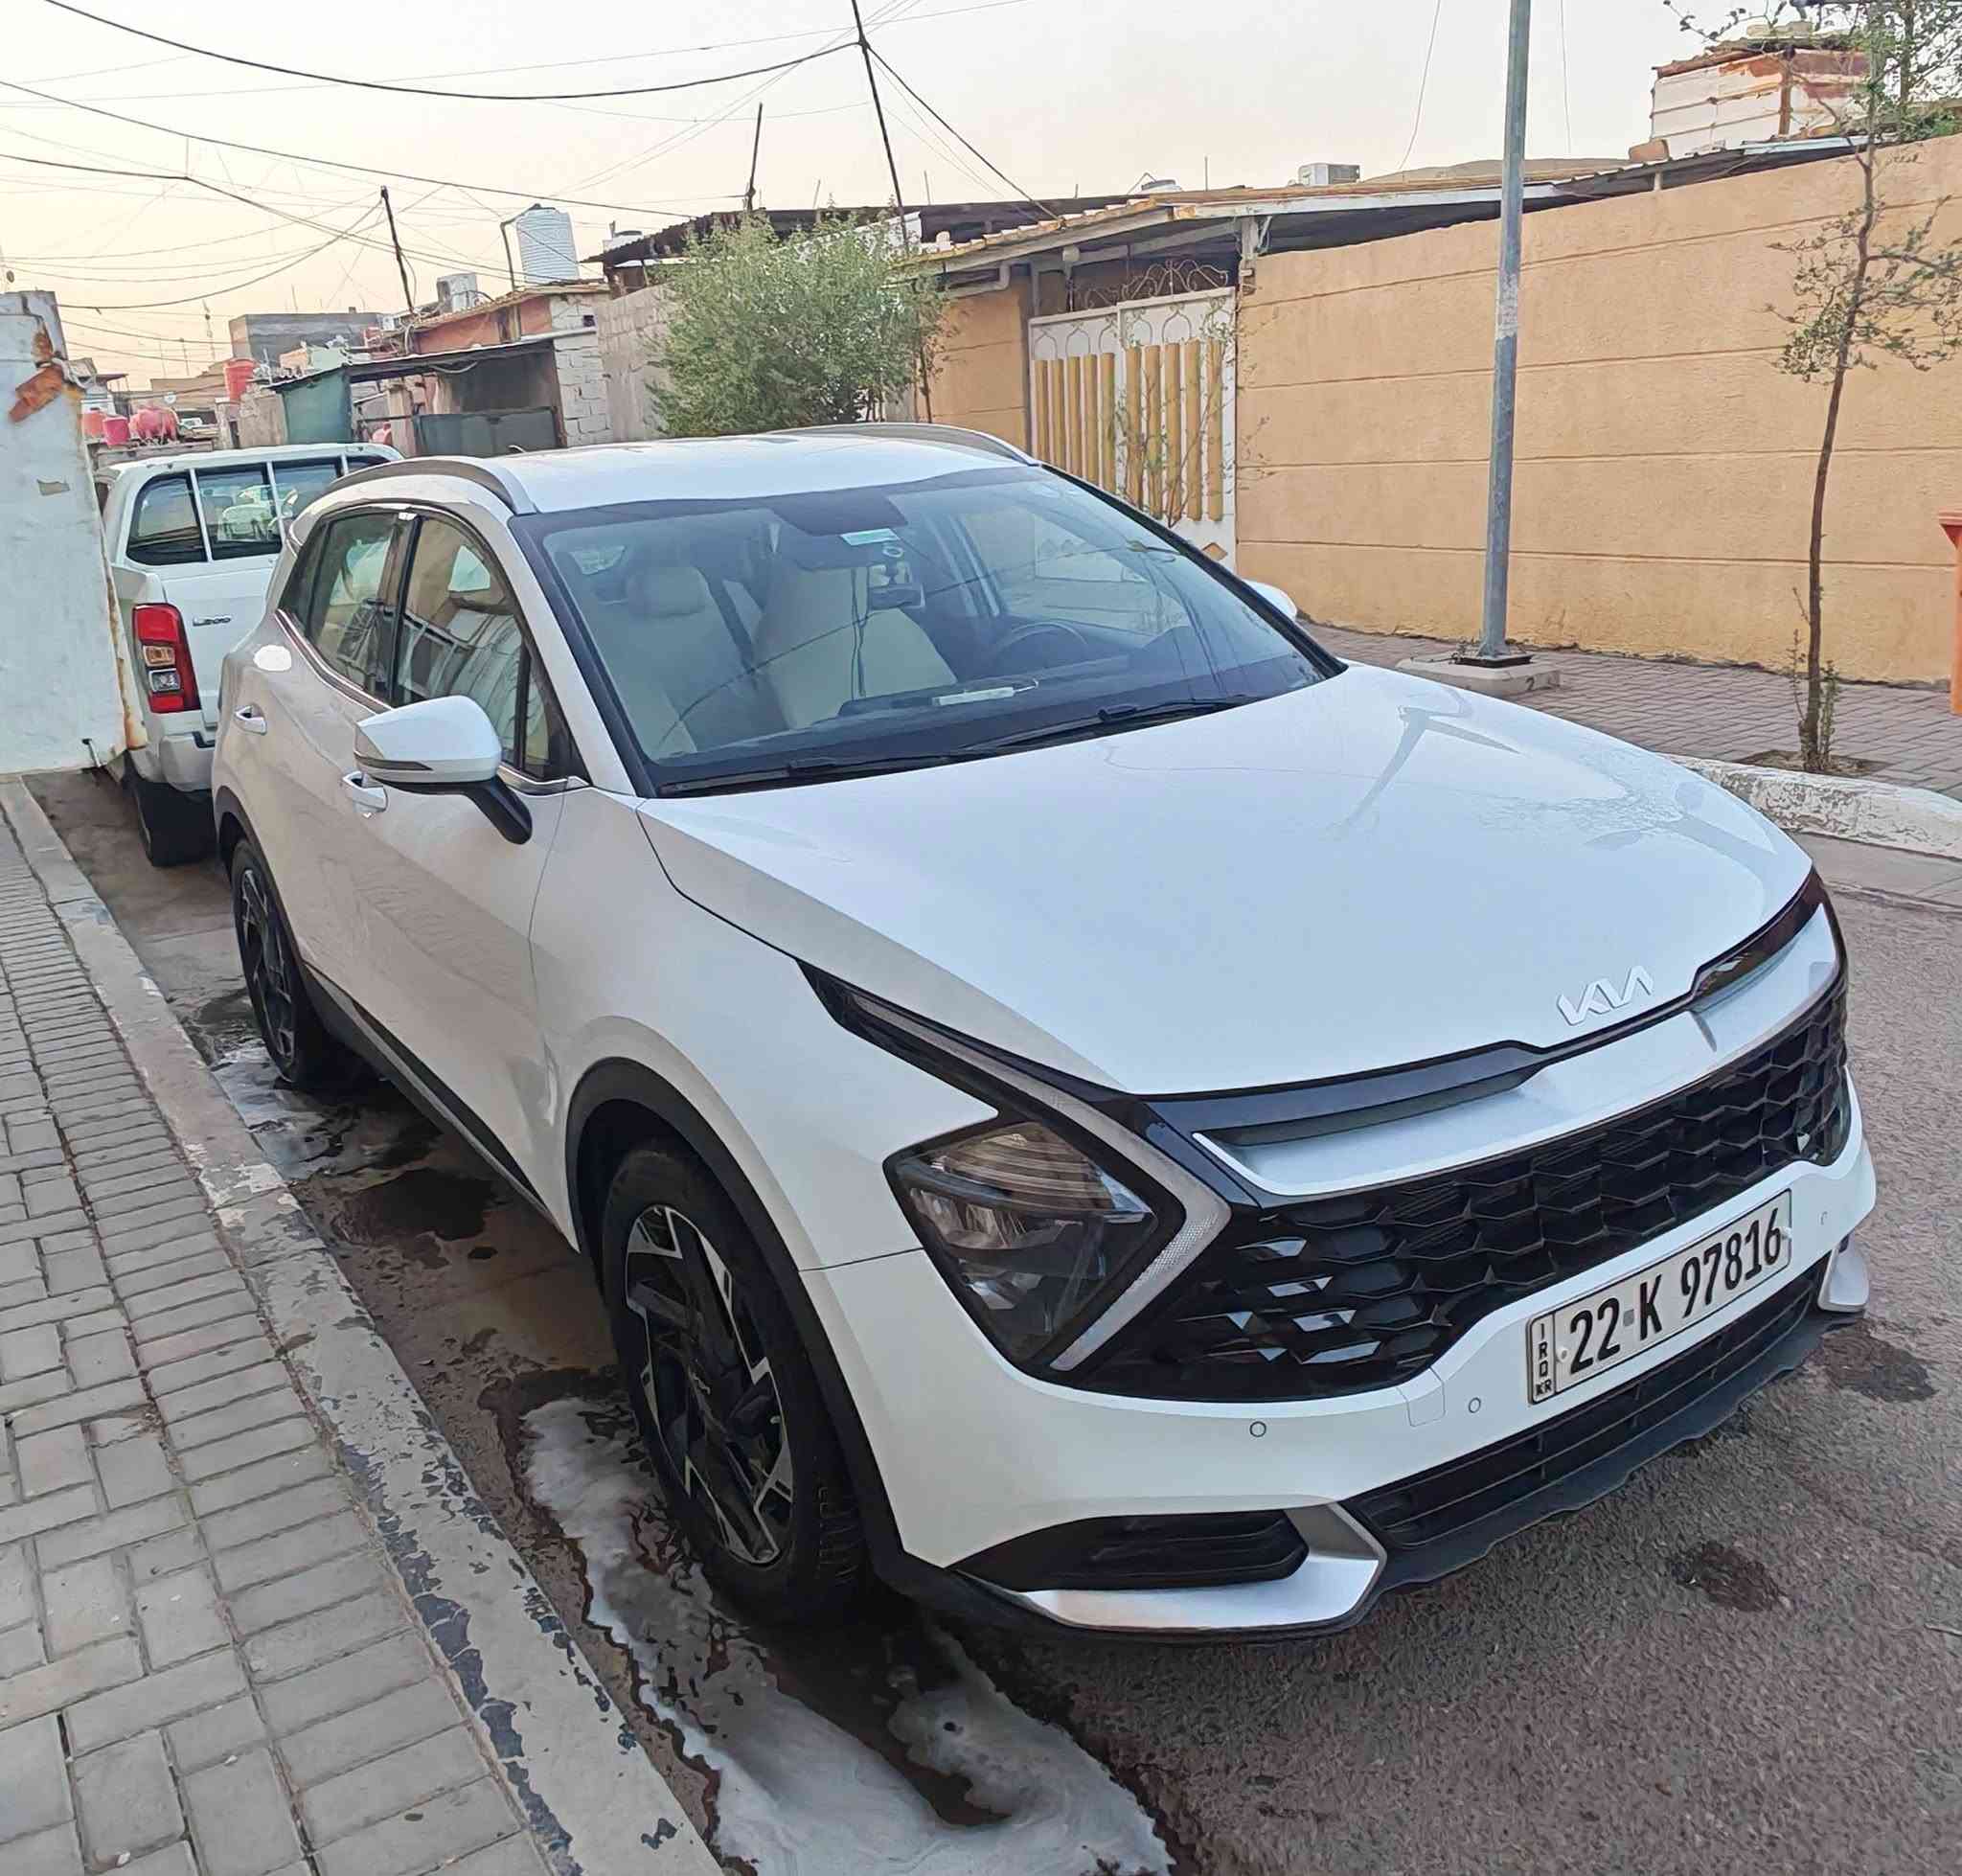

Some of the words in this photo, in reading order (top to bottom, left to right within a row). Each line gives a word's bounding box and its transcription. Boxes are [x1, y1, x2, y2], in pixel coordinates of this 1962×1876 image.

[1556, 965, 1654, 1026] KIA
[1569, 1297, 1621, 1374] 22
[1639, 1274, 1662, 1340] K
[1680, 1208, 1782, 1318] 97816
[1536, 1379, 1552, 1396] KR
